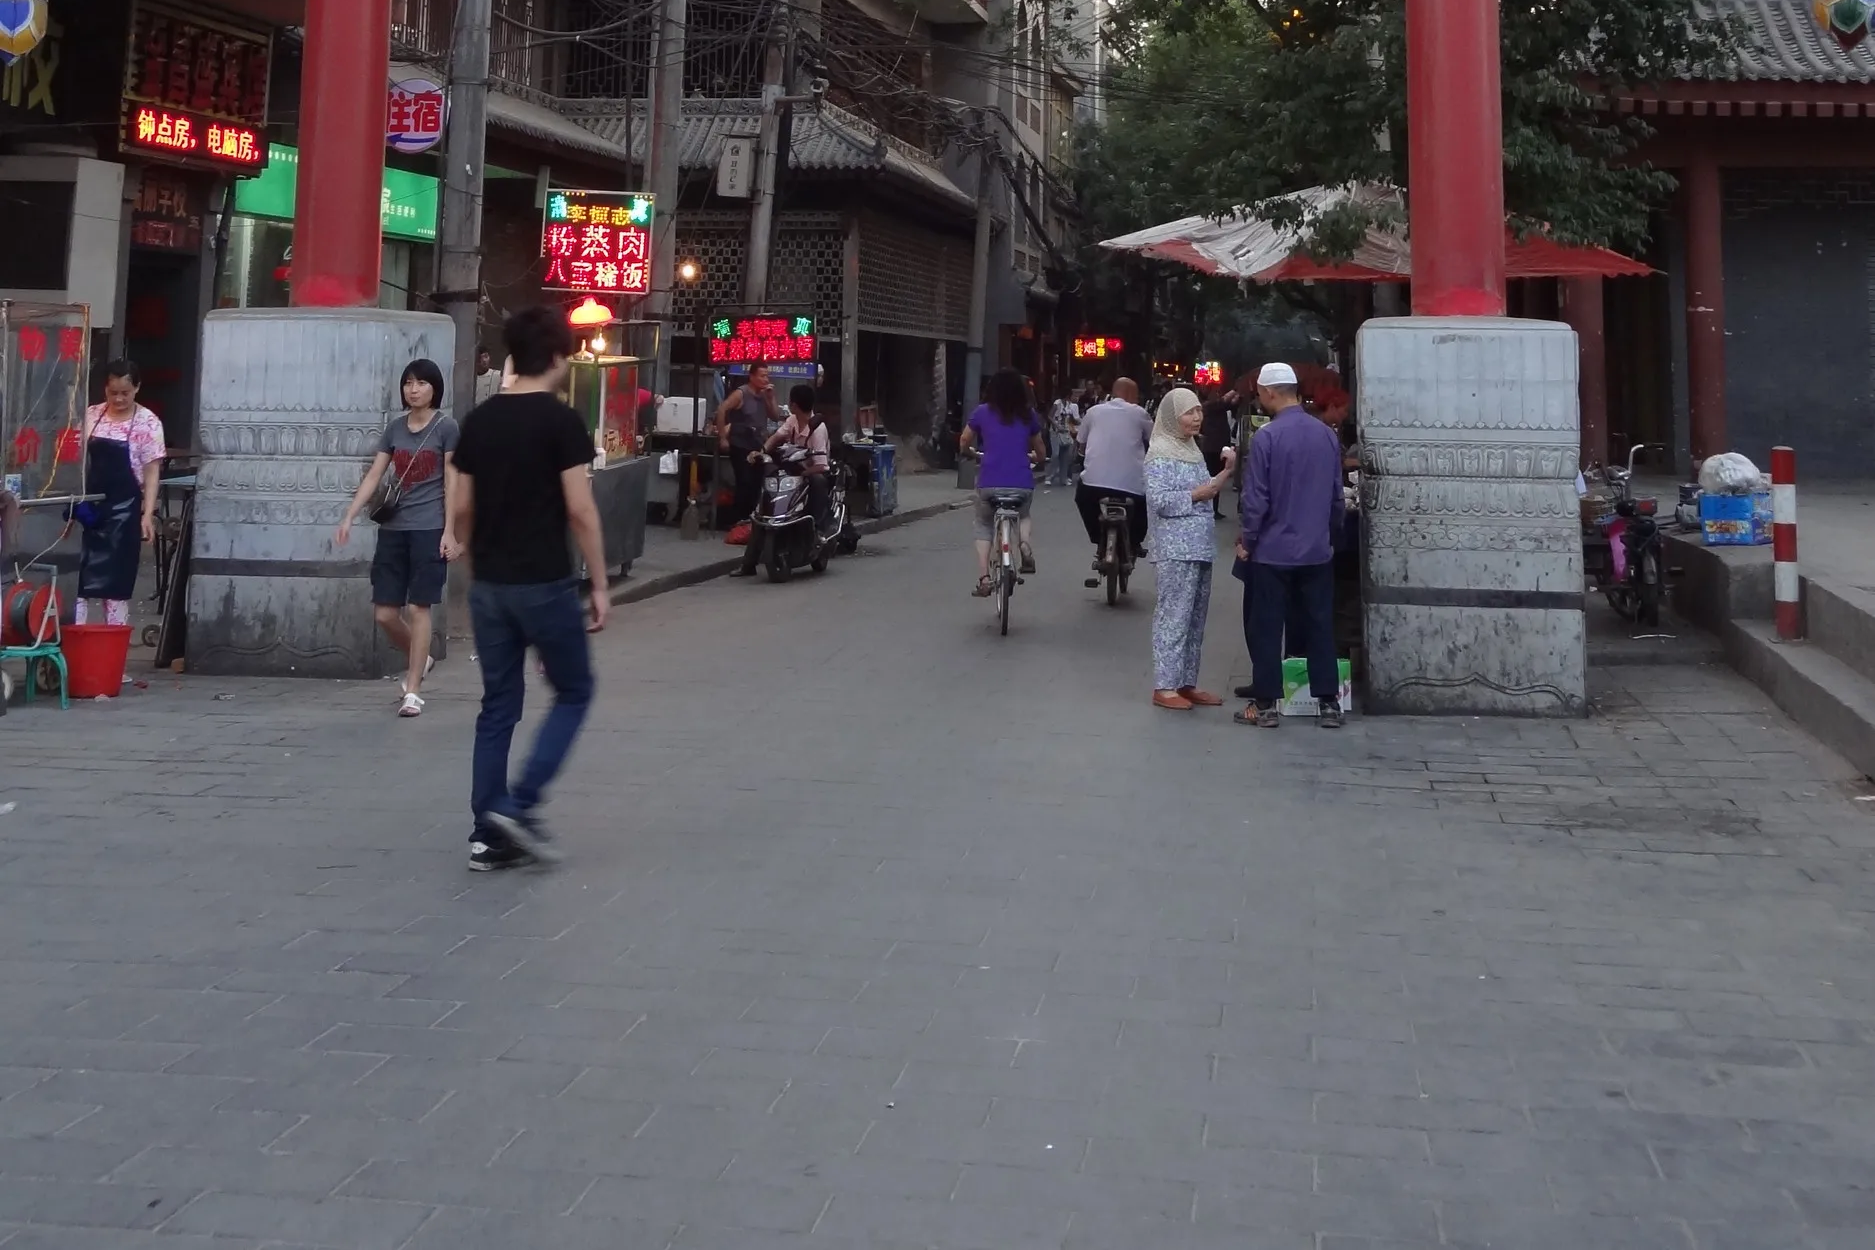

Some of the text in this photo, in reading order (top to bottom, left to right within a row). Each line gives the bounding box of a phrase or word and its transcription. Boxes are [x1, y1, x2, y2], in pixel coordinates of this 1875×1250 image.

[387, 90, 443, 133] 住宿
[548, 224, 646, 260] 粉蒸肉
[545, 259, 643, 288] 八宝稀饭
